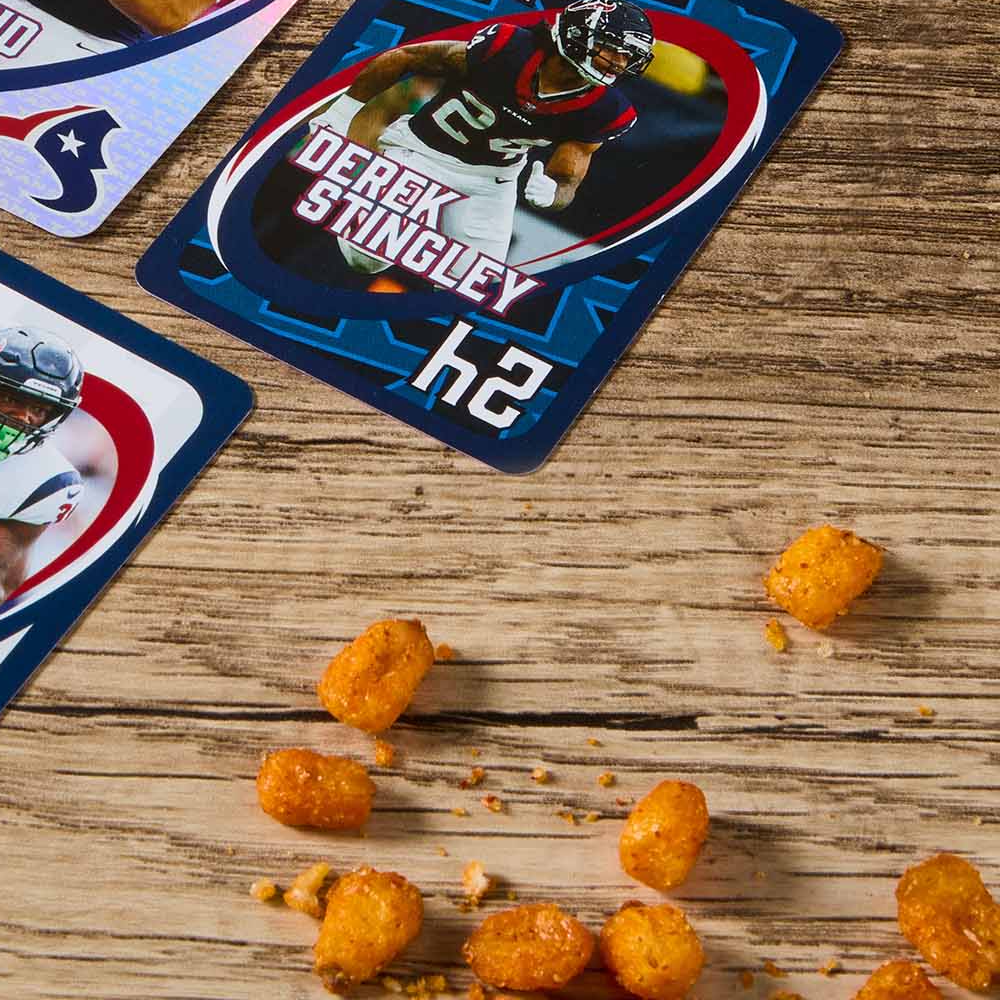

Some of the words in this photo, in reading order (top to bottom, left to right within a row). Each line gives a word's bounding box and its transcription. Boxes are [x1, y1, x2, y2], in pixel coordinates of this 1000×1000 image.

[294, 124, 472, 233] DEREK
[432, 90, 552, 161] 24
[295, 178, 547, 316] STINGLEY
[410, 318, 556, 431] 24
